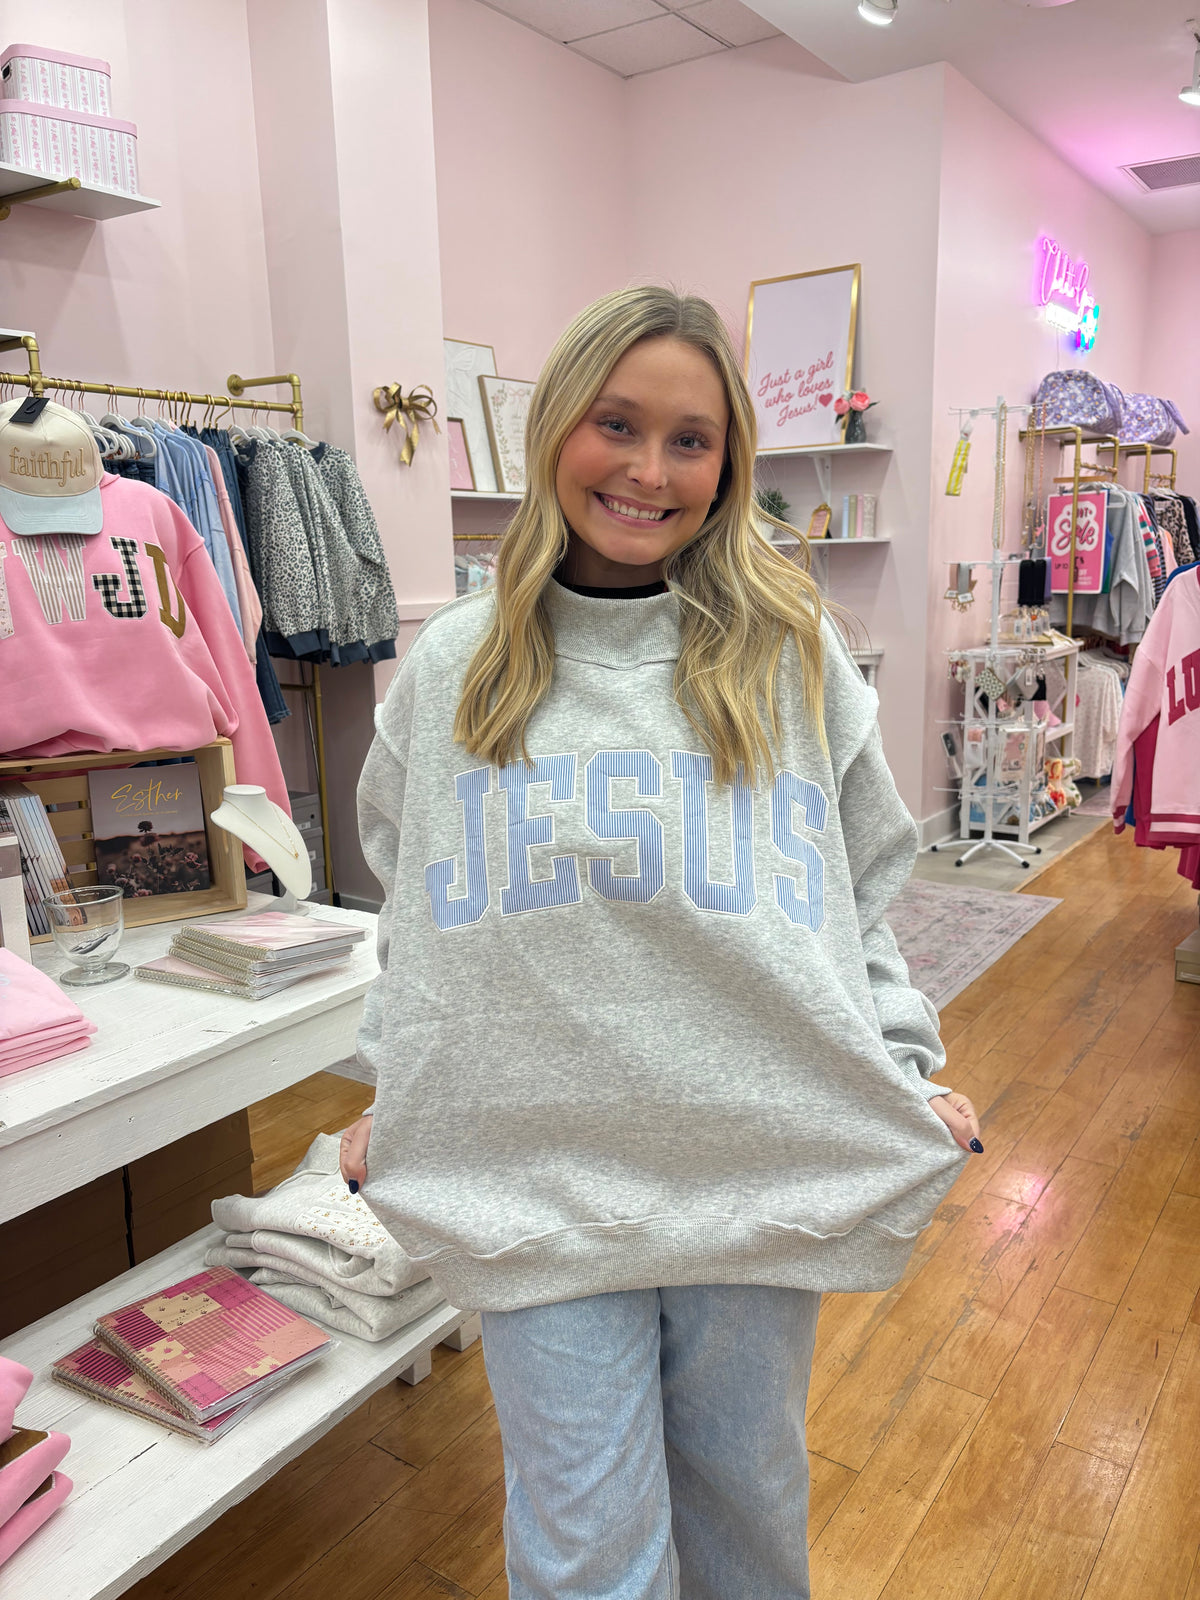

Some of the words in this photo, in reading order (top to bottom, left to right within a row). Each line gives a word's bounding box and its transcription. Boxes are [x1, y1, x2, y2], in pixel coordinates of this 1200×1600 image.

[757, 369, 791, 397] Just
[794, 369, 805, 380] a
[806, 350, 834, 384] girl
[765, 387, 795, 408] who
[798, 379, 834, 398] loves
[777, 393, 819, 427] Jesus!
[9, 446, 86, 488] faithful
[0, 535, 187, 639] WJD
[111, 778, 182, 812] Esther
[424, 750, 829, 935] JESUS
